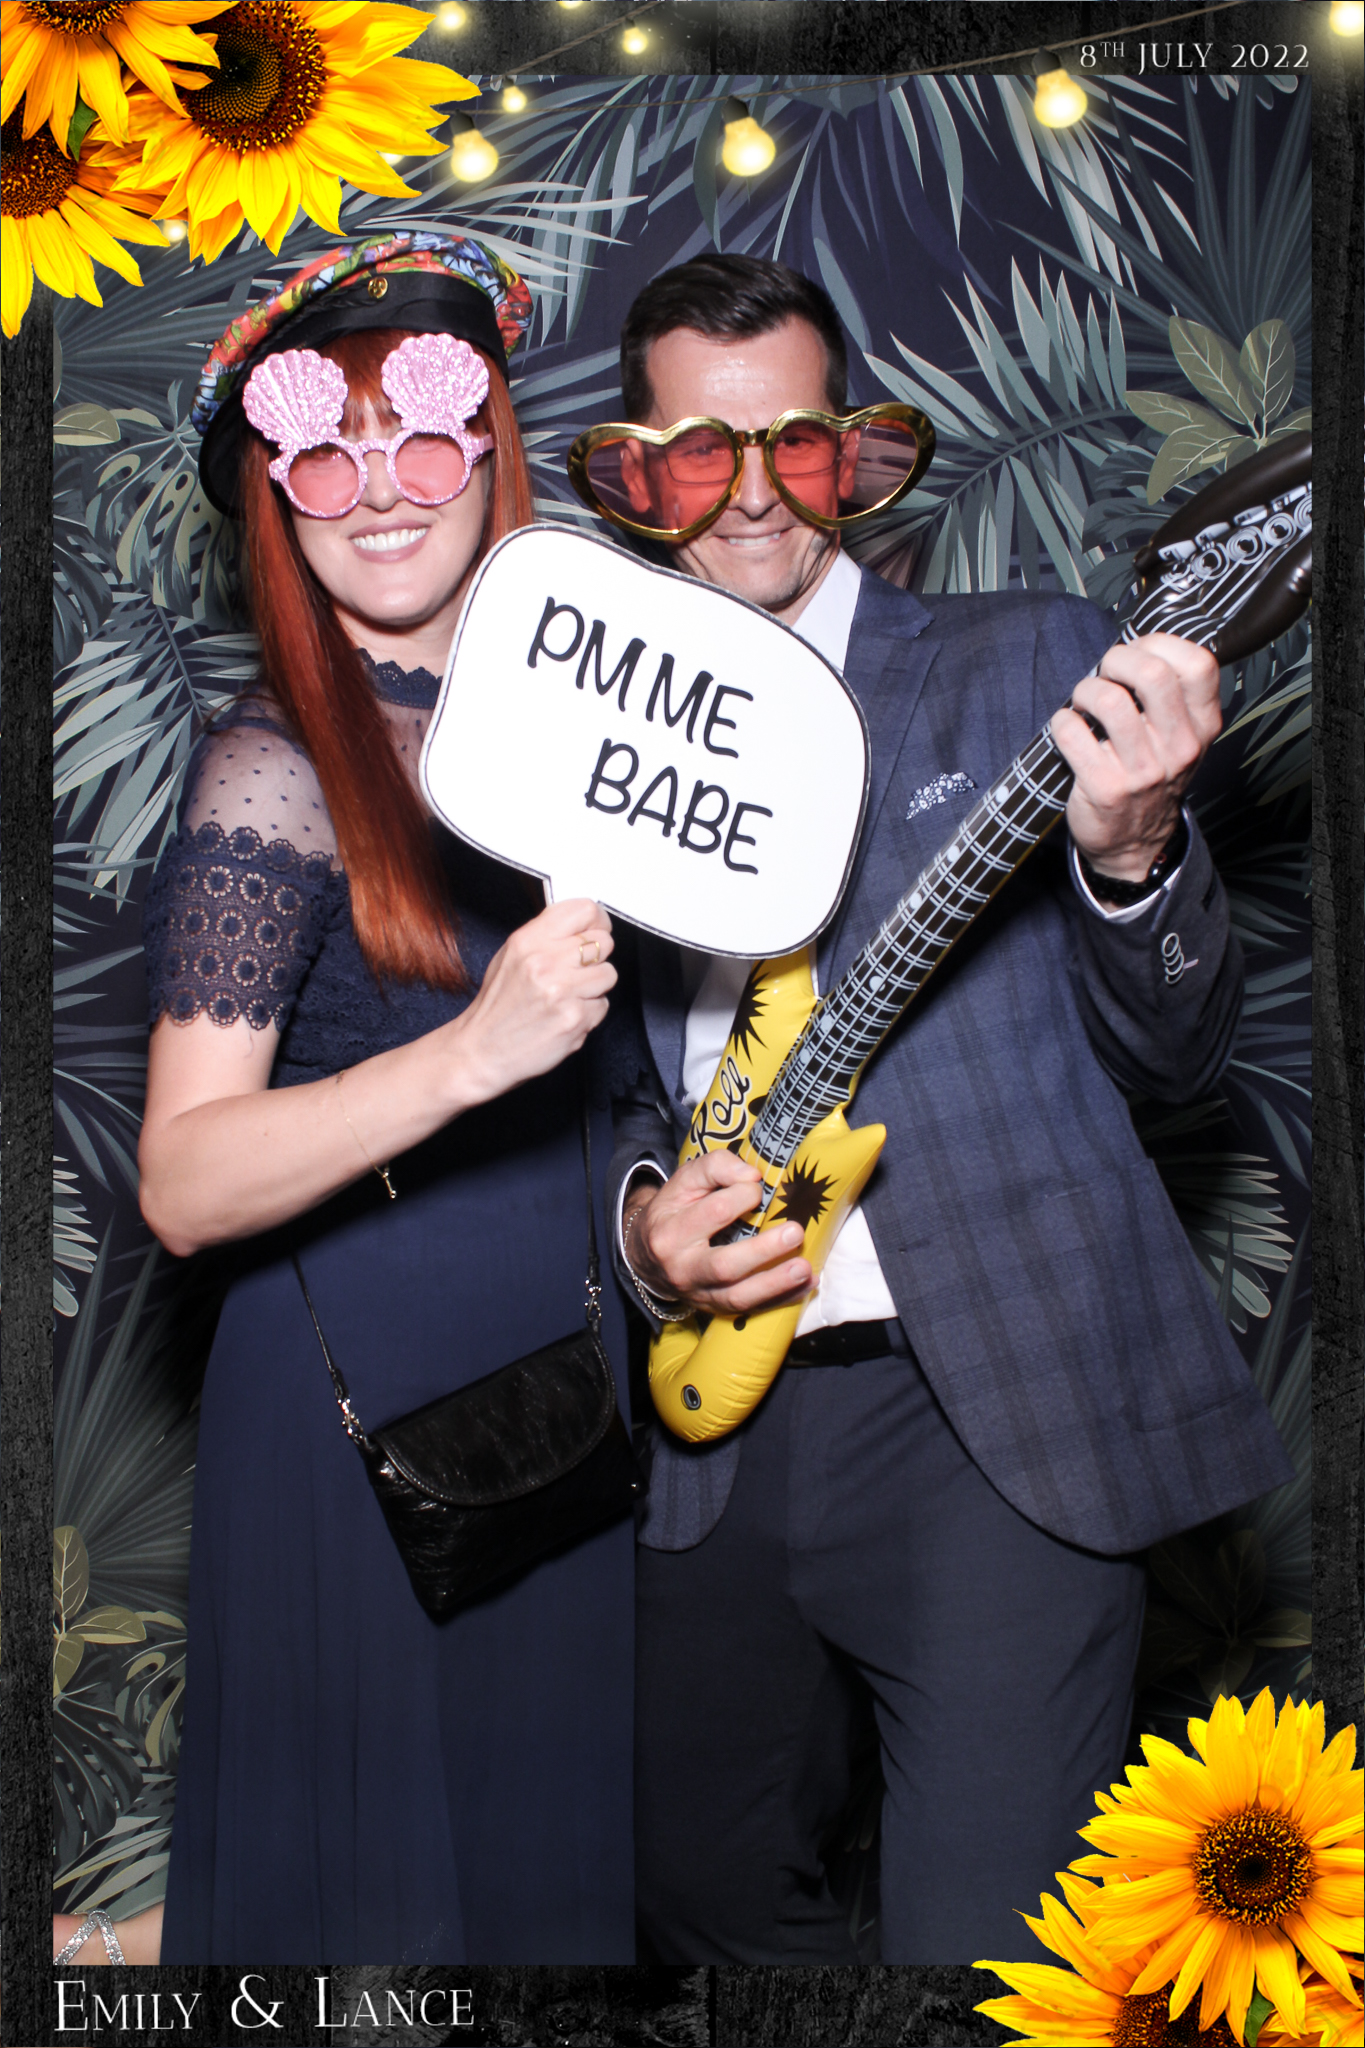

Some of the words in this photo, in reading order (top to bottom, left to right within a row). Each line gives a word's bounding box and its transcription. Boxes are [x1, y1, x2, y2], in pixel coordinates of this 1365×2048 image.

[528, 596, 647, 712] PM
[645, 653, 754, 758] ME
[585, 738, 774, 874] BABE
